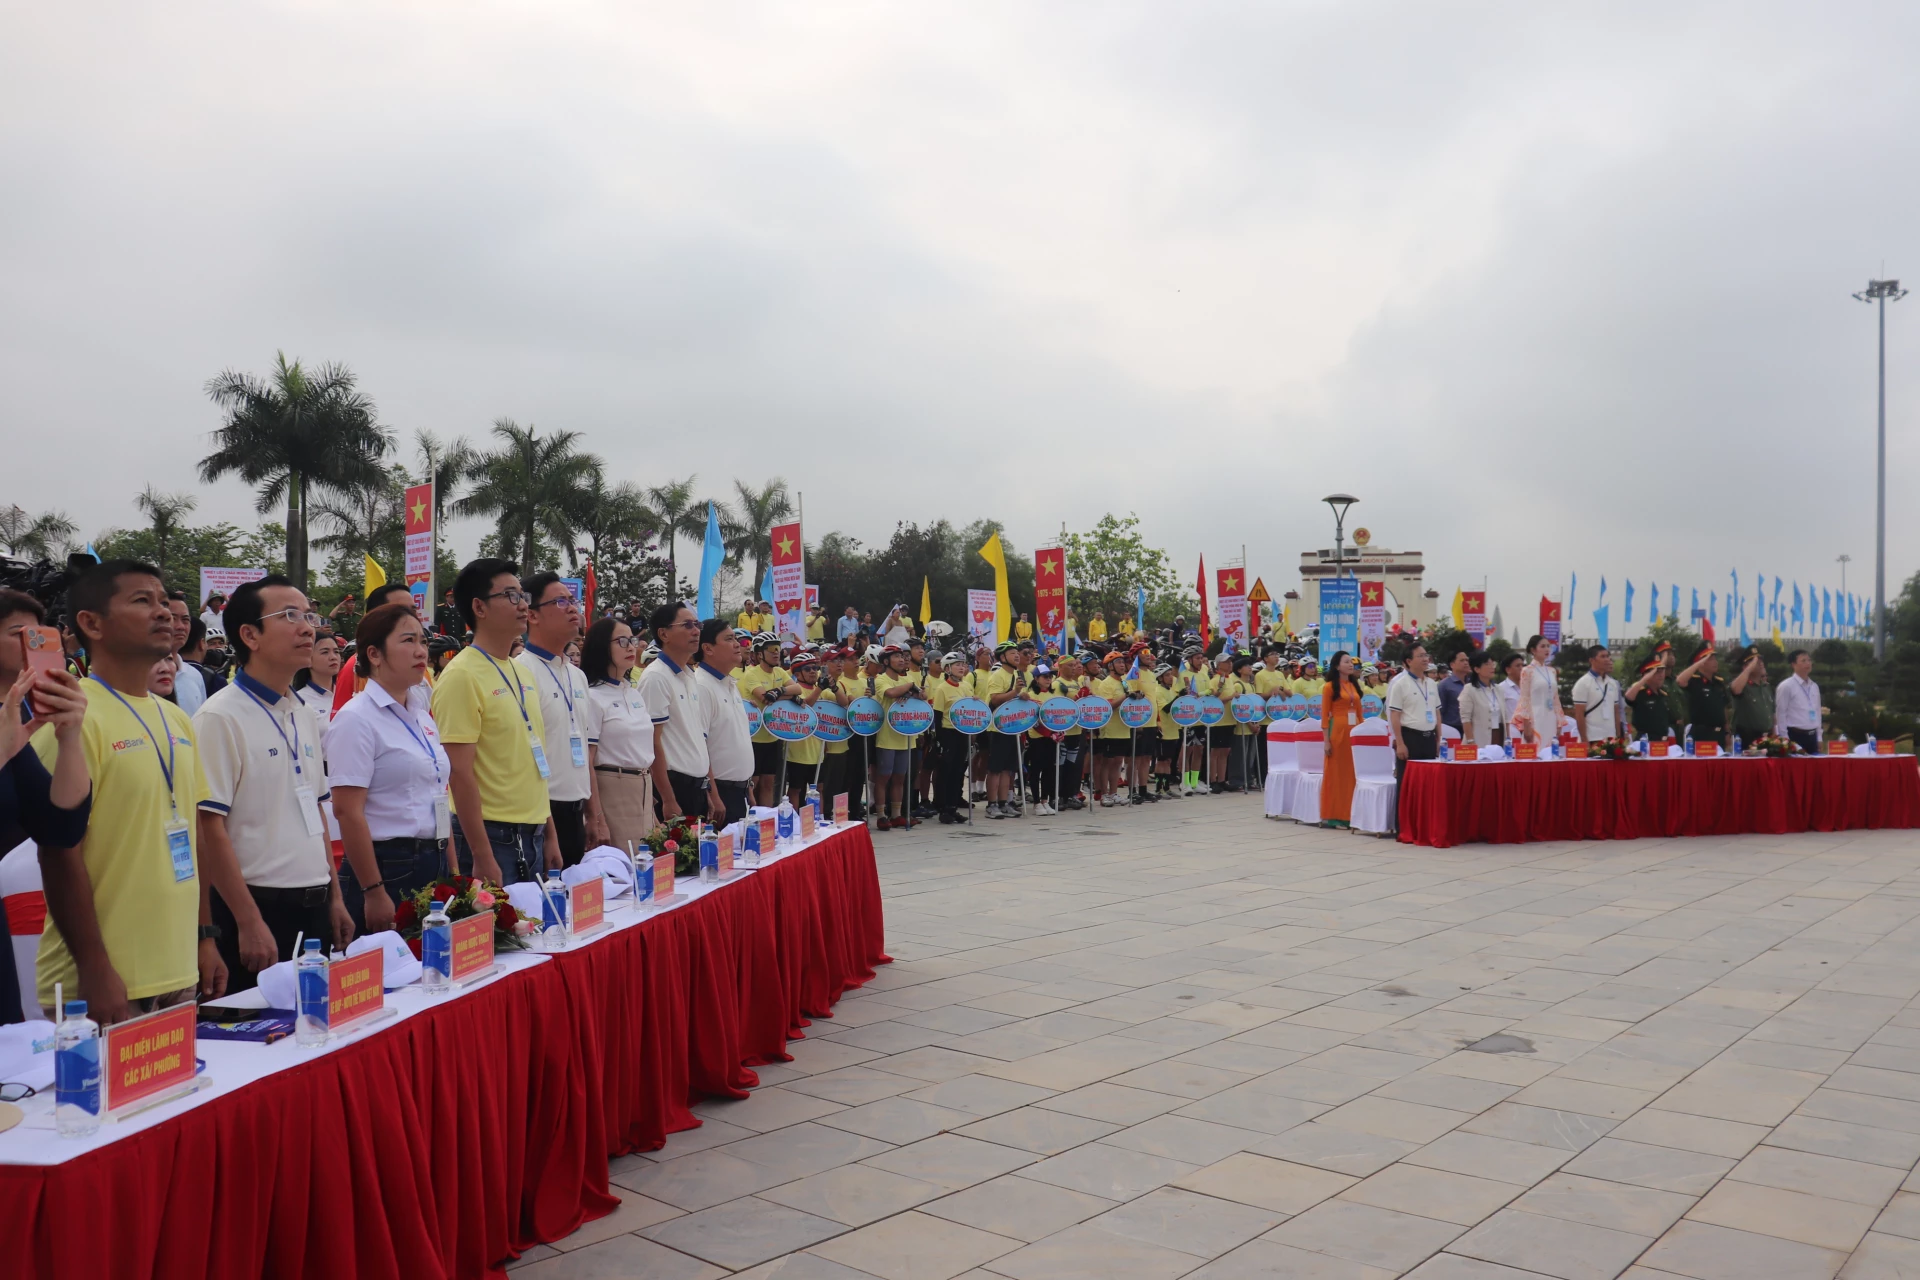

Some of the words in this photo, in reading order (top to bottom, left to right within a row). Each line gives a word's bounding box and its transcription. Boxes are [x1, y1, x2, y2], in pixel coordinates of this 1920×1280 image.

[413, 594, 424, 611] 51
[1324, 612, 1337, 624] CHÀO
[112, 738, 144, 751] HDBank
[120, 1046, 133, 1064] ĐẠI
[134, 1038, 151, 1058] DIỆN
[152, 1033, 169, 1052] LÃNH
[171, 1027, 184, 1046] ĐẠO
[124, 1068, 139, 1088] CÁC
[153, 1053, 181, 1077] PHƯỜNG
